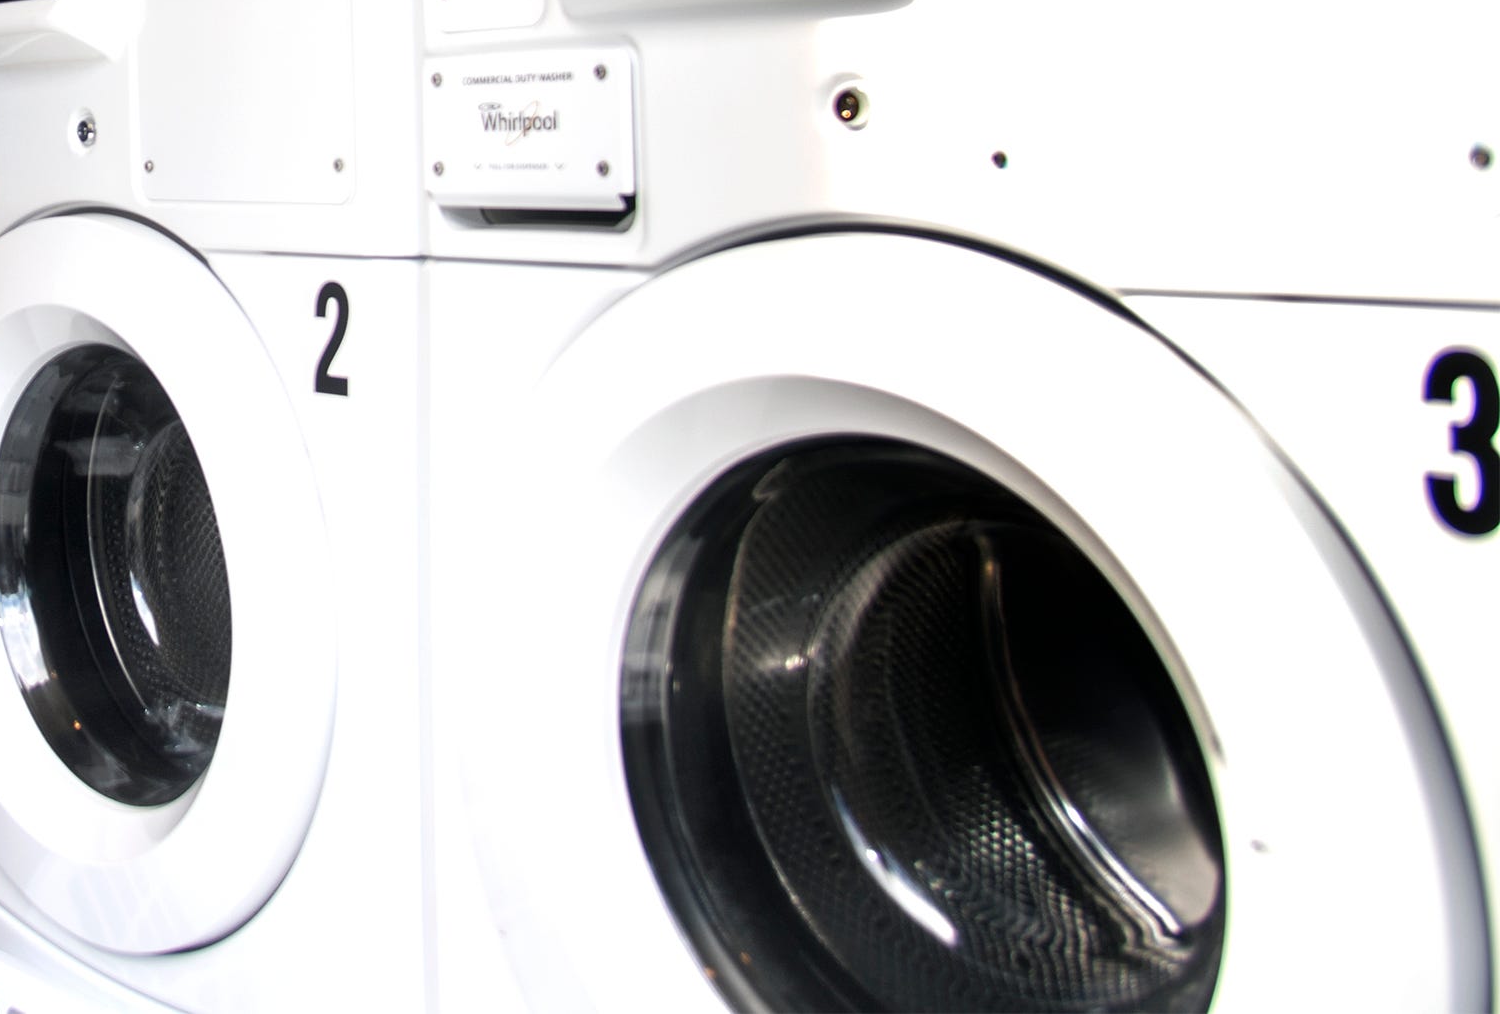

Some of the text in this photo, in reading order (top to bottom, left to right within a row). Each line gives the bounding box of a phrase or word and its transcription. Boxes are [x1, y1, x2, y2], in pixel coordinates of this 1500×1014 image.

[462, 71, 574, 86] COMMERCIAL DUTY WASHER
[480, 110, 560, 137] Whirlpool
[313, 279, 349, 397] 2
[1422, 345, 1500, 542] 3
